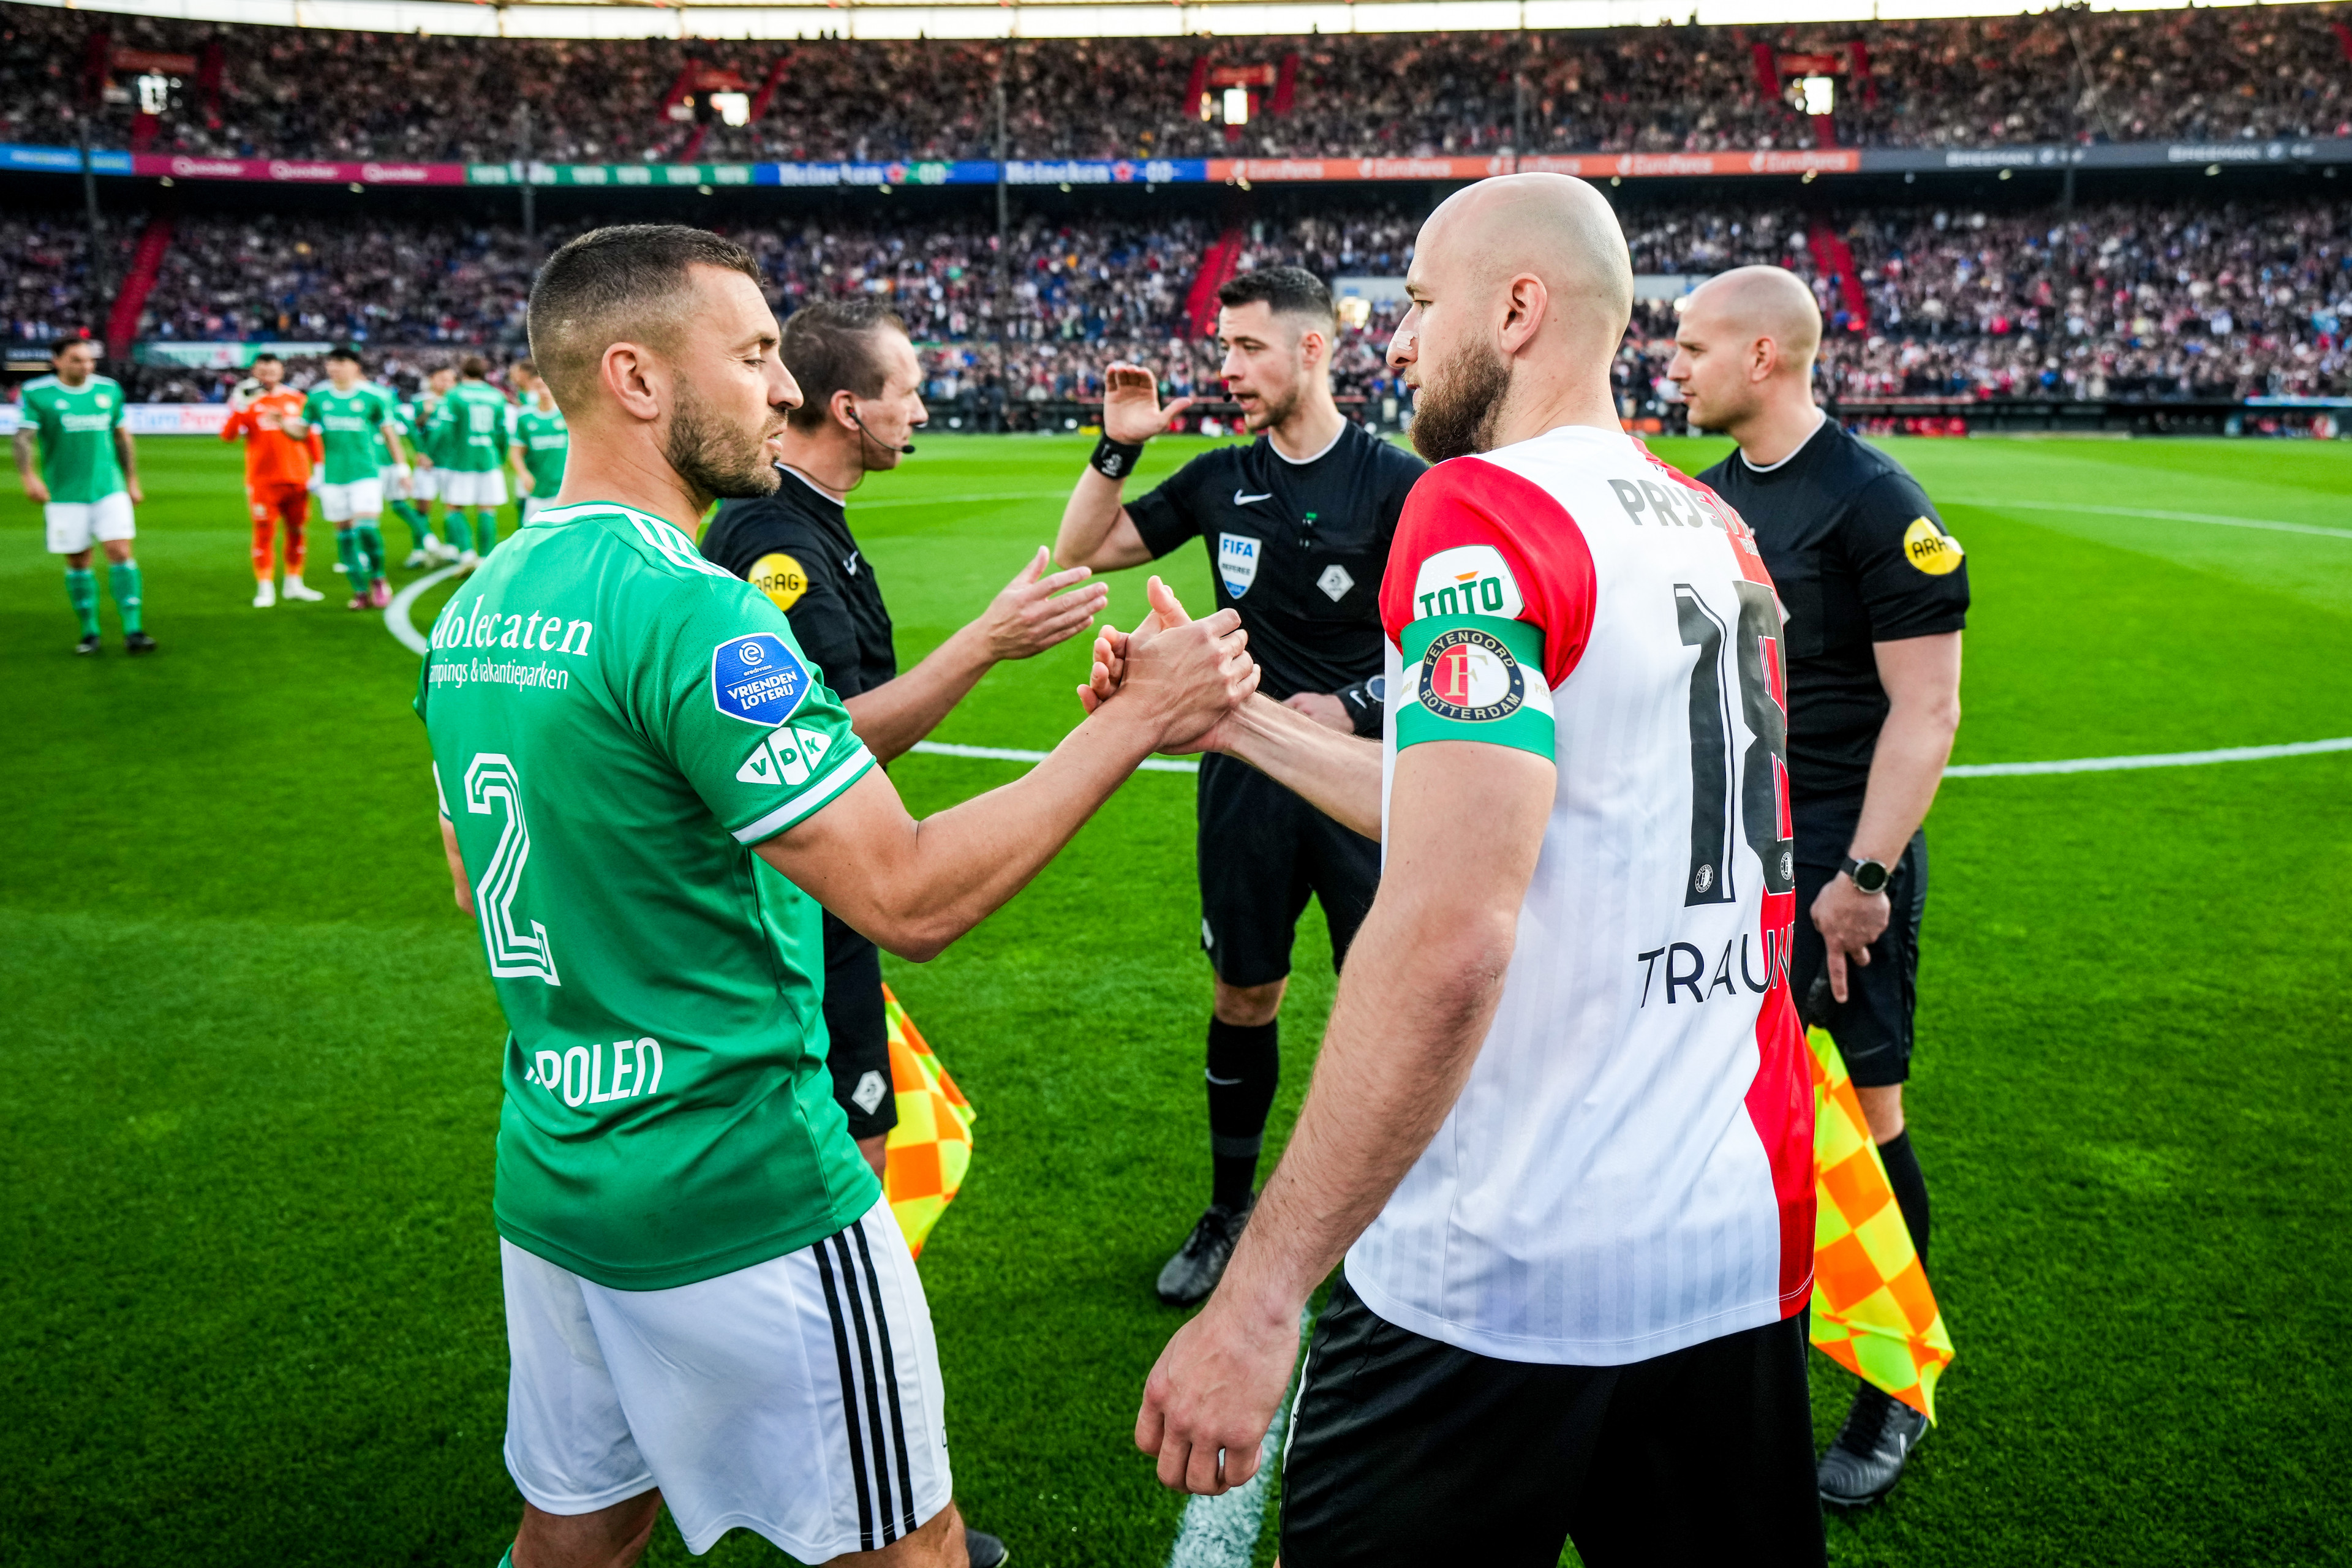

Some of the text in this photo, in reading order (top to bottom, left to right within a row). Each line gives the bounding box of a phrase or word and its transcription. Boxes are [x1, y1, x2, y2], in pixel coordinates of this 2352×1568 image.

[1223, 539, 1253, 557] FIFA
[1419, 576, 1504, 617] TOTO
[1425, 631, 1515, 668] FEYENOORD
[470, 657, 479, 682] &
[727, 671, 798, 700] VRIENDEN
[743, 664, 772, 677] eredivisie
[1444, 654, 1489, 696] F
[740, 683, 794, 710] LOTERIJ
[1420, 692, 1521, 720] ROTTERDAM
[750, 737, 821, 777] VDK
[1673, 579, 1795, 908] 18
[464, 753, 561, 987] 2
